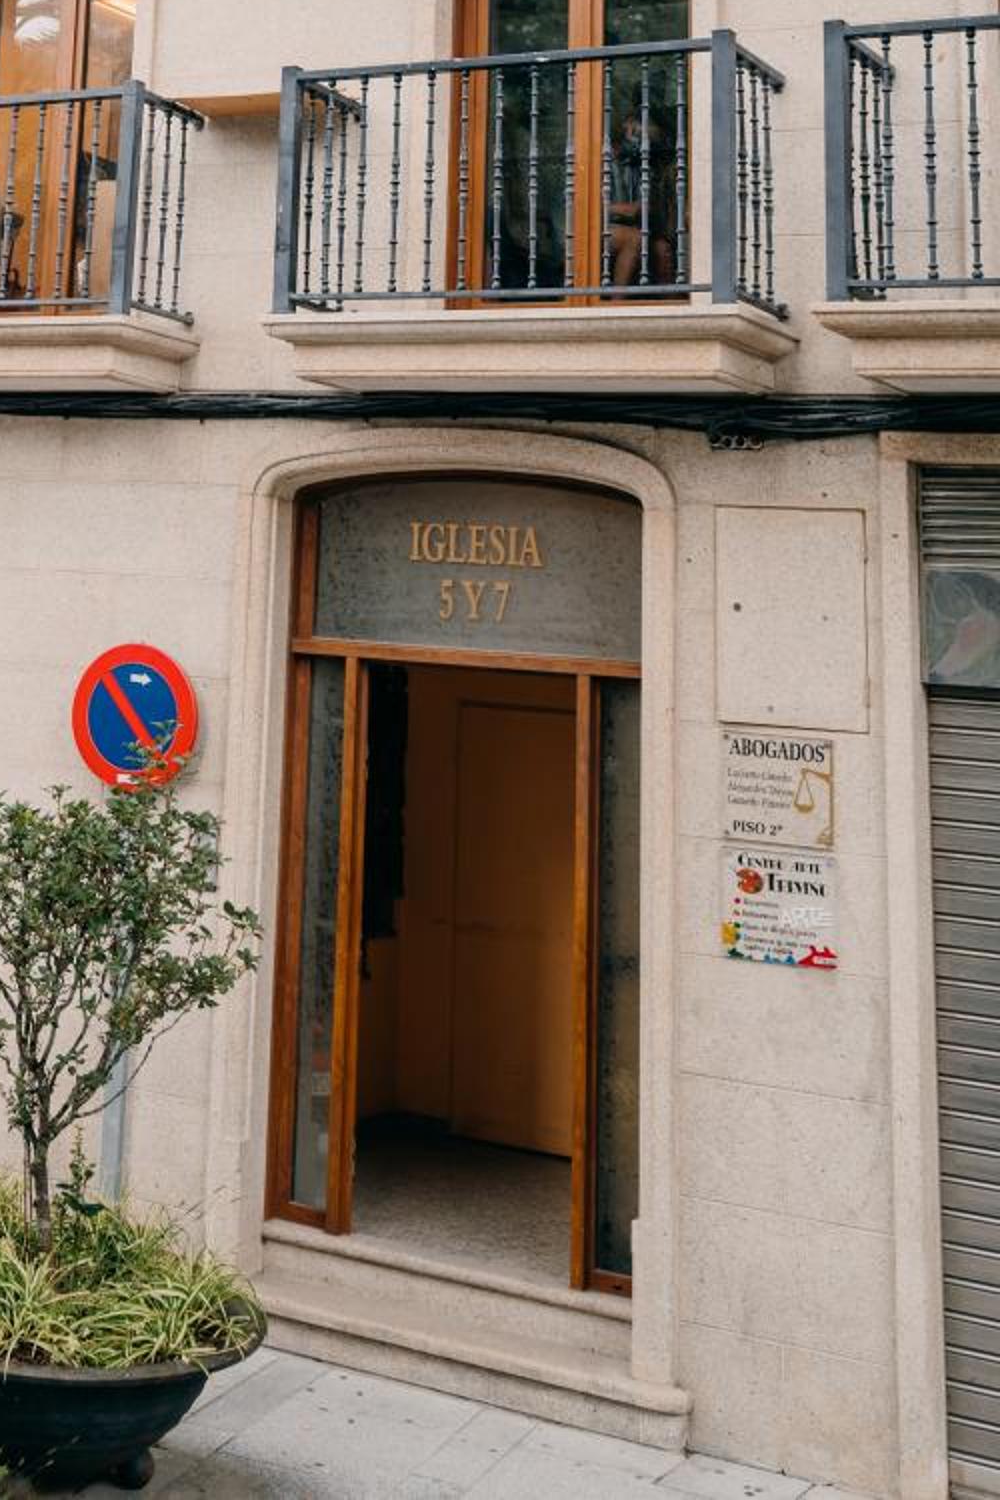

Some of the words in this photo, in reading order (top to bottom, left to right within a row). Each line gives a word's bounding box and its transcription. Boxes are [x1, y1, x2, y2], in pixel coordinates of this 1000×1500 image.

[409, 521, 545, 568] IGLESIA
[439, 579, 454, 621] 5
[461, 579, 487, 621] Y
[488, 580, 511, 623] 7
[728, 737, 826, 764] ABOGADOS
[732, 819, 766, 835] PISO
